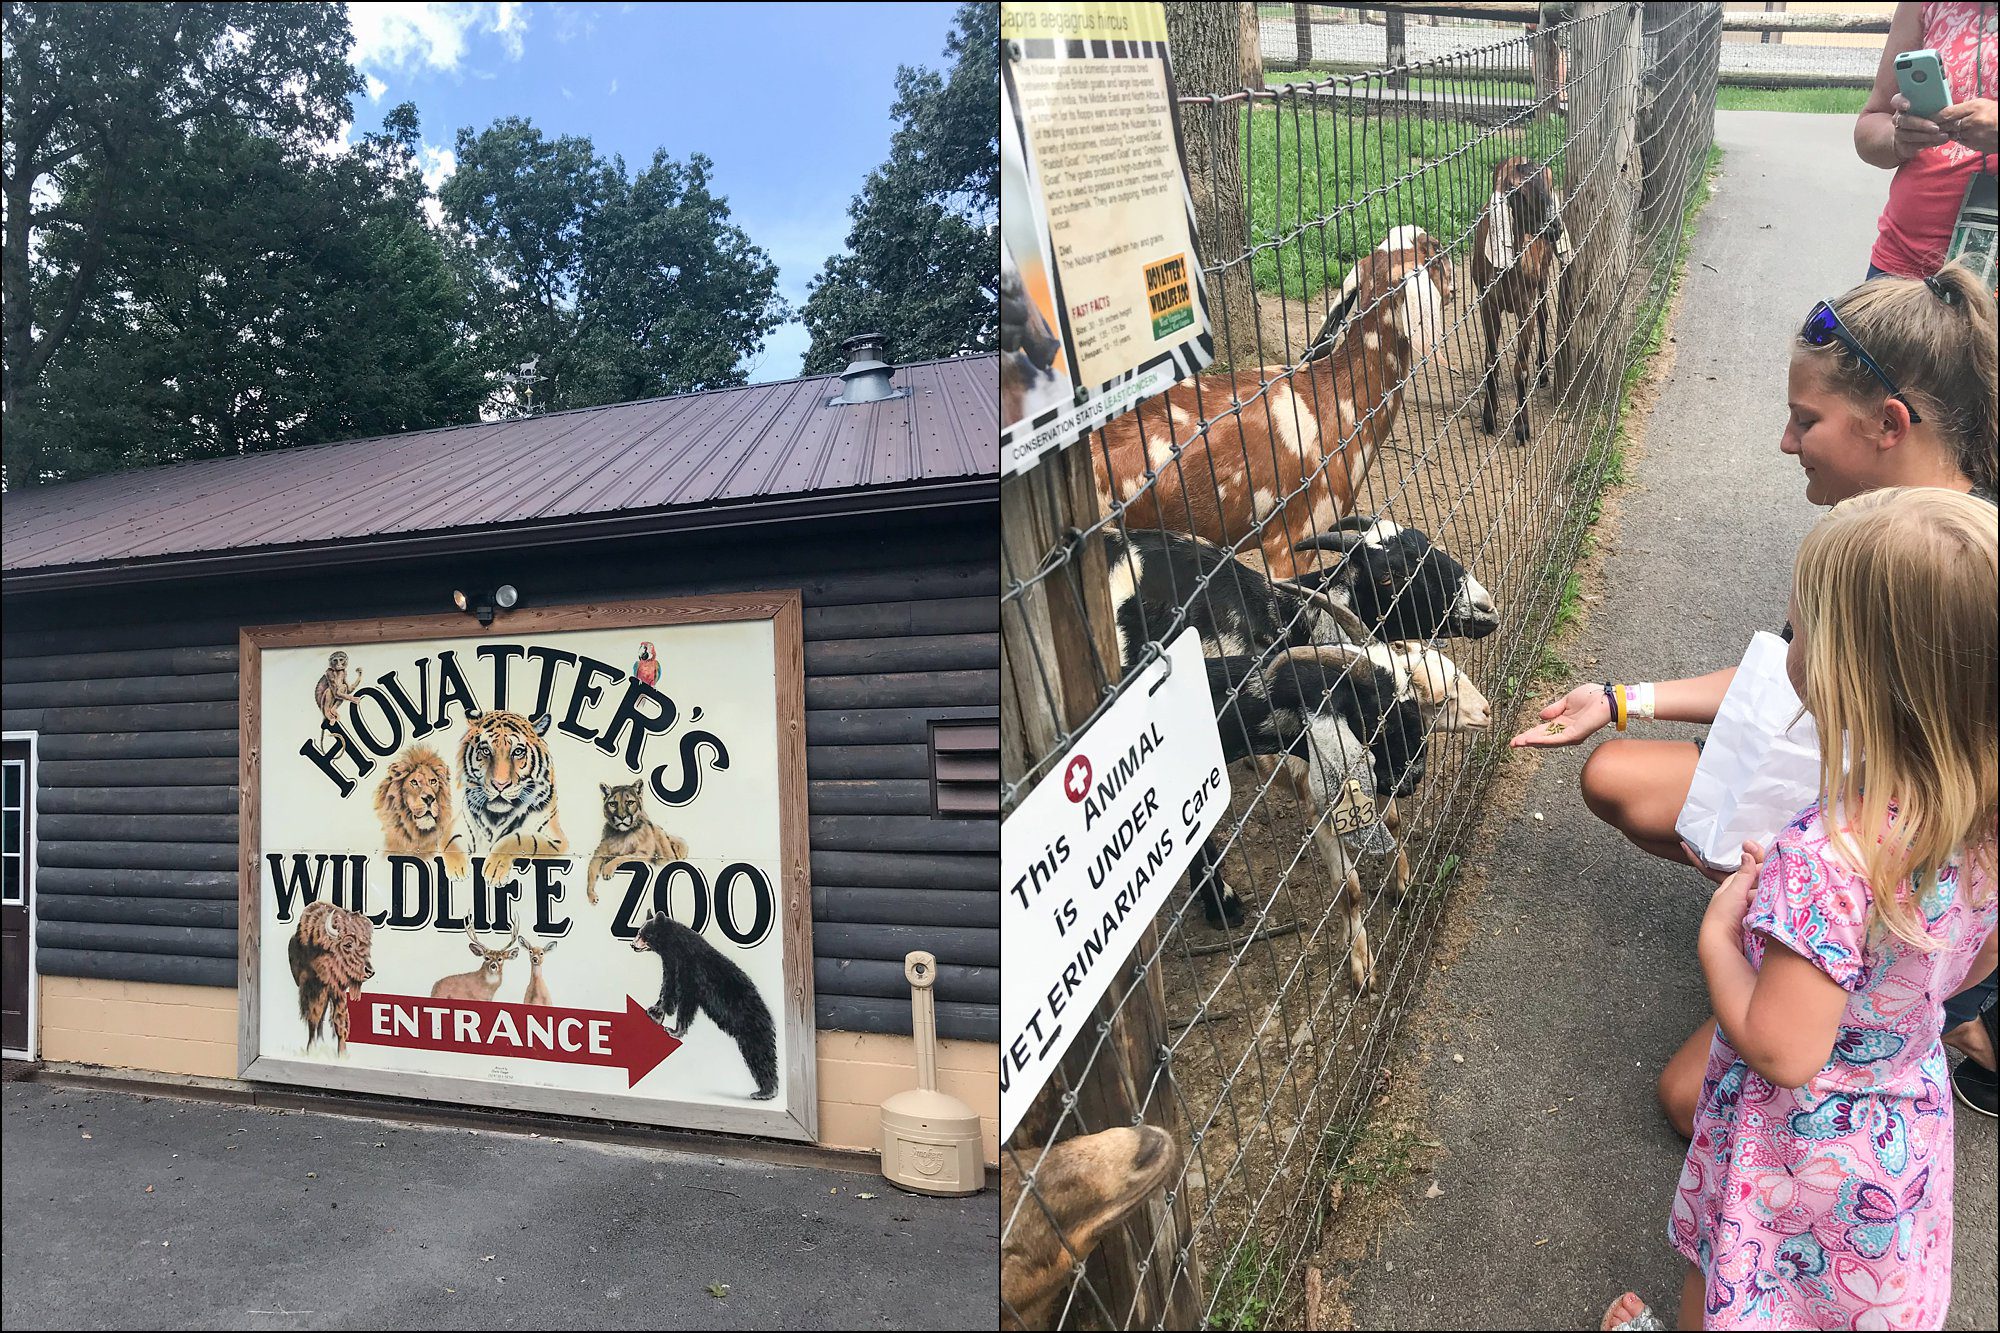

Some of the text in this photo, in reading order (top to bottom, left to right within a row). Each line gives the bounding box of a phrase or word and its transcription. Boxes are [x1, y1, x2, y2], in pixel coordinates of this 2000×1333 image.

[1040, 11, 1095, 34] aegagrus
[1098, 10, 1128, 31] hircus
[1146, 257, 1186, 291] HOVATTER'S
[1150, 281, 1190, 314] WILDLIFE ZOO
[1071, 295, 1111, 319] FAST FACTS
[1012, 373, 1158, 460] CONSERVATION STATUS LEAST CONCERN
[299, 644, 731, 807] HOVATTER'S
[1010, 721, 1165, 909] This ANIMAL
[1182, 766, 1221, 828] Care
[1335, 801, 1374, 831] 583
[1053, 786, 1159, 938] is UNDER
[266, 853, 777, 949] WILDLIFE ZOO
[370, 1002, 614, 1057] ENTRANCE
